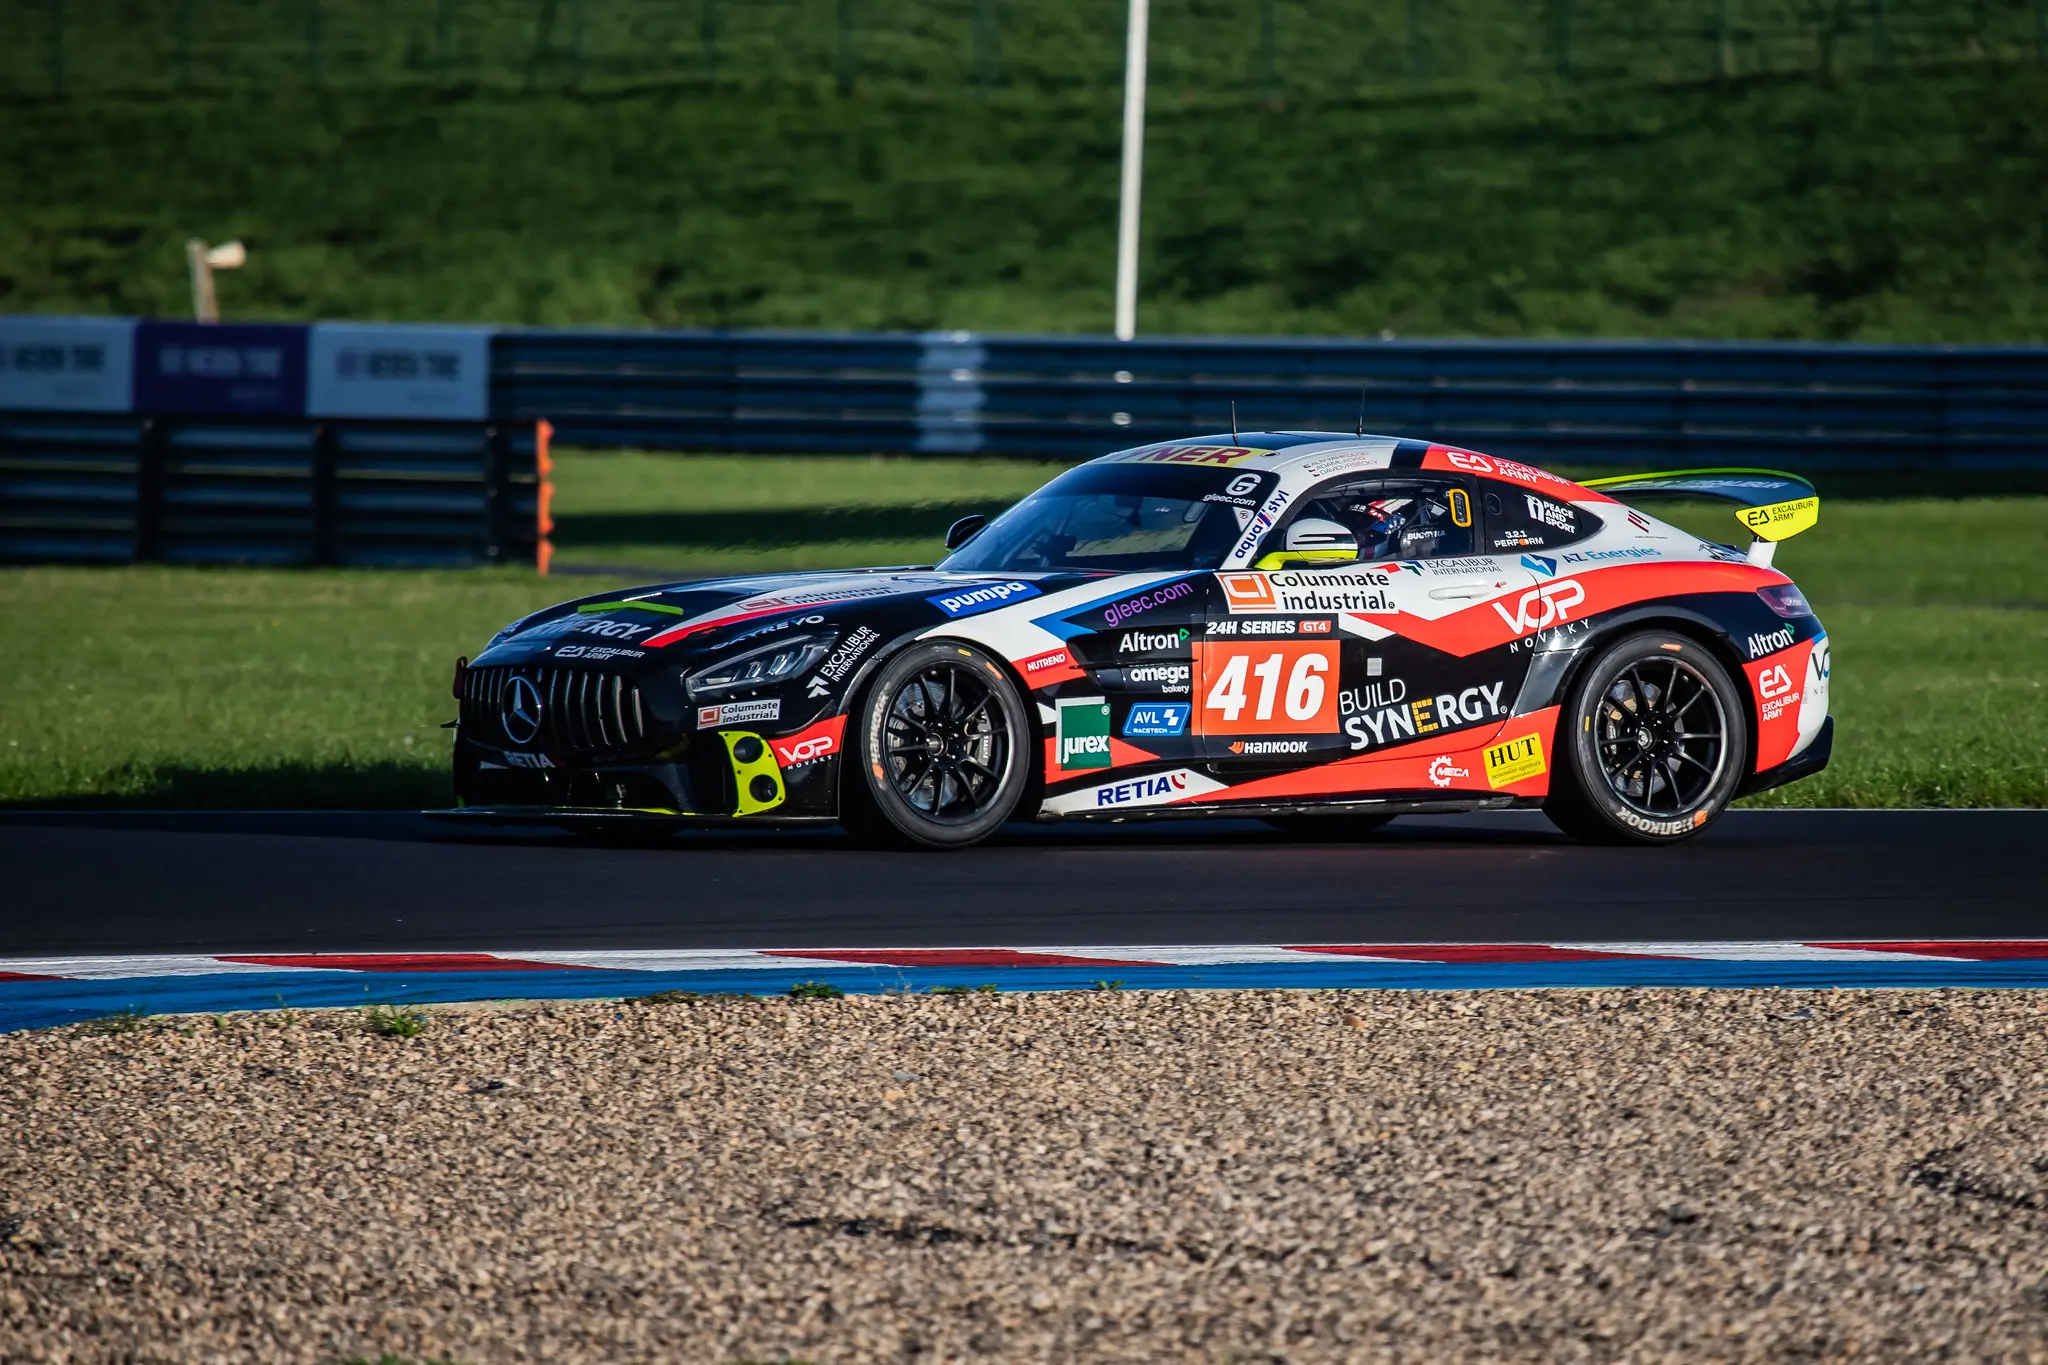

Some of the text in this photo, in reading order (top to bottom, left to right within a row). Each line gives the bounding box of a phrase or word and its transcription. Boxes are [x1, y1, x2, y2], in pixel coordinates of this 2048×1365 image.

[1492, 459, 1570, 487] EXCALIBUR
[1499, 467, 1538, 484] ARMY
[1202, 492, 1257, 507] gleec.com
[1772, 500, 1814, 515] EXCALIBUR
[1543, 500, 1575, 519] PEACE
[1545, 509, 1567, 523] AND
[1773, 511, 1796, 523] ARMY
[1234, 489, 1290, 559] aqua styl
[1545, 517, 1576, 534] SPORT
[1424, 557, 1497, 569] EXCALIBUR
[1562, 546, 1663, 565] AZ Energies
[1268, 572, 1390, 588] Columnate
[1431, 565, 1504, 576] INTERNATIONAL
[939, 580, 1028, 613] pumpa
[1103, 580, 1194, 628] gleec.com
[1491, 579, 1586, 635] VOP
[1205, 620, 1328, 635] 24H SERIES GT4
[819, 625, 874, 678] EXCALIBUR
[1119, 632, 1180, 653] Altron
[1747, 628, 1795, 659] Altron
[582, 652, 615, 661] ARMY
[589, 646, 646, 659] EXCALIBUR
[830, 631, 881, 683] INTERNATIONAL
[1026, 653, 1066, 672] NUTREND
[1130, 665, 1190, 684] omega
[1161, 684, 1190, 694] bakery
[1205, 653, 1329, 721] 416
[1338, 678, 1407, 716] BUILD
[1761, 692, 1801, 713] EXCALIBUR
[720, 701, 779, 715] Columnate
[1133, 711, 1160, 724] AVL
[1762, 707, 1783, 722] ARMY
[778, 736, 833, 762] VOP
[1062, 734, 1110, 764] jurex
[1489, 736, 1536, 768] HUT
[1097, 776, 1172, 807] RETIA
